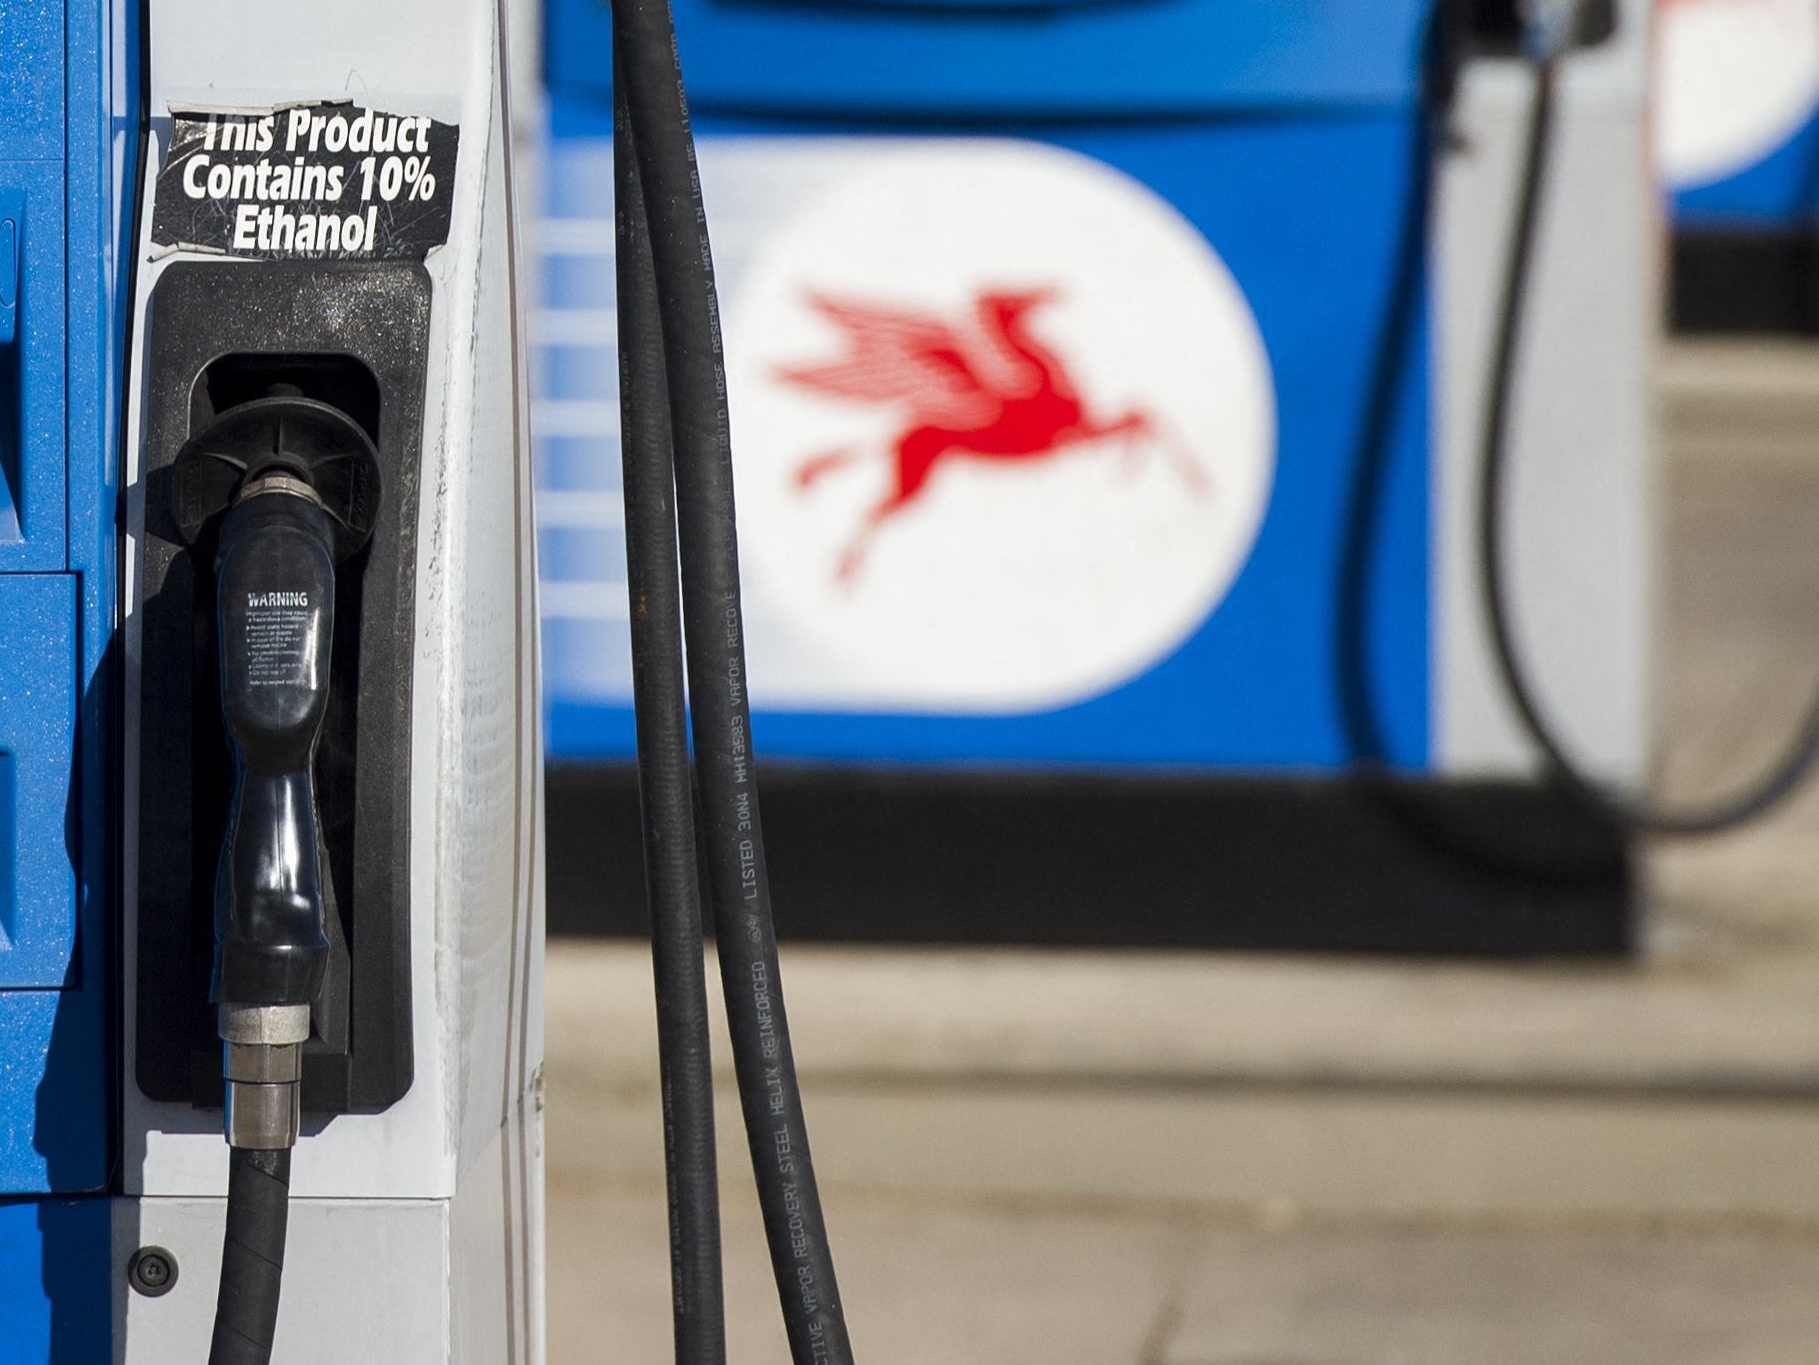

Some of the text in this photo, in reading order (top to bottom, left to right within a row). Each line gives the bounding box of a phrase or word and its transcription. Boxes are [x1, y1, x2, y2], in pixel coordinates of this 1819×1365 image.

[286, 108, 431, 153] Product
[183, 154, 436, 202] Contains 10%
[233, 204, 378, 251] Ethanol
[248, 592, 309, 607] WARNING
[740, 840, 757, 900] LISTED
[751, 961, 778, 1059] REINFORCED
[766, 1066, 784, 1116] HELIX
[774, 1123, 794, 1172] STEEL
[783, 1182, 807, 1259] RECOVERY
[798, 1265, 817, 1314] VAPOR
